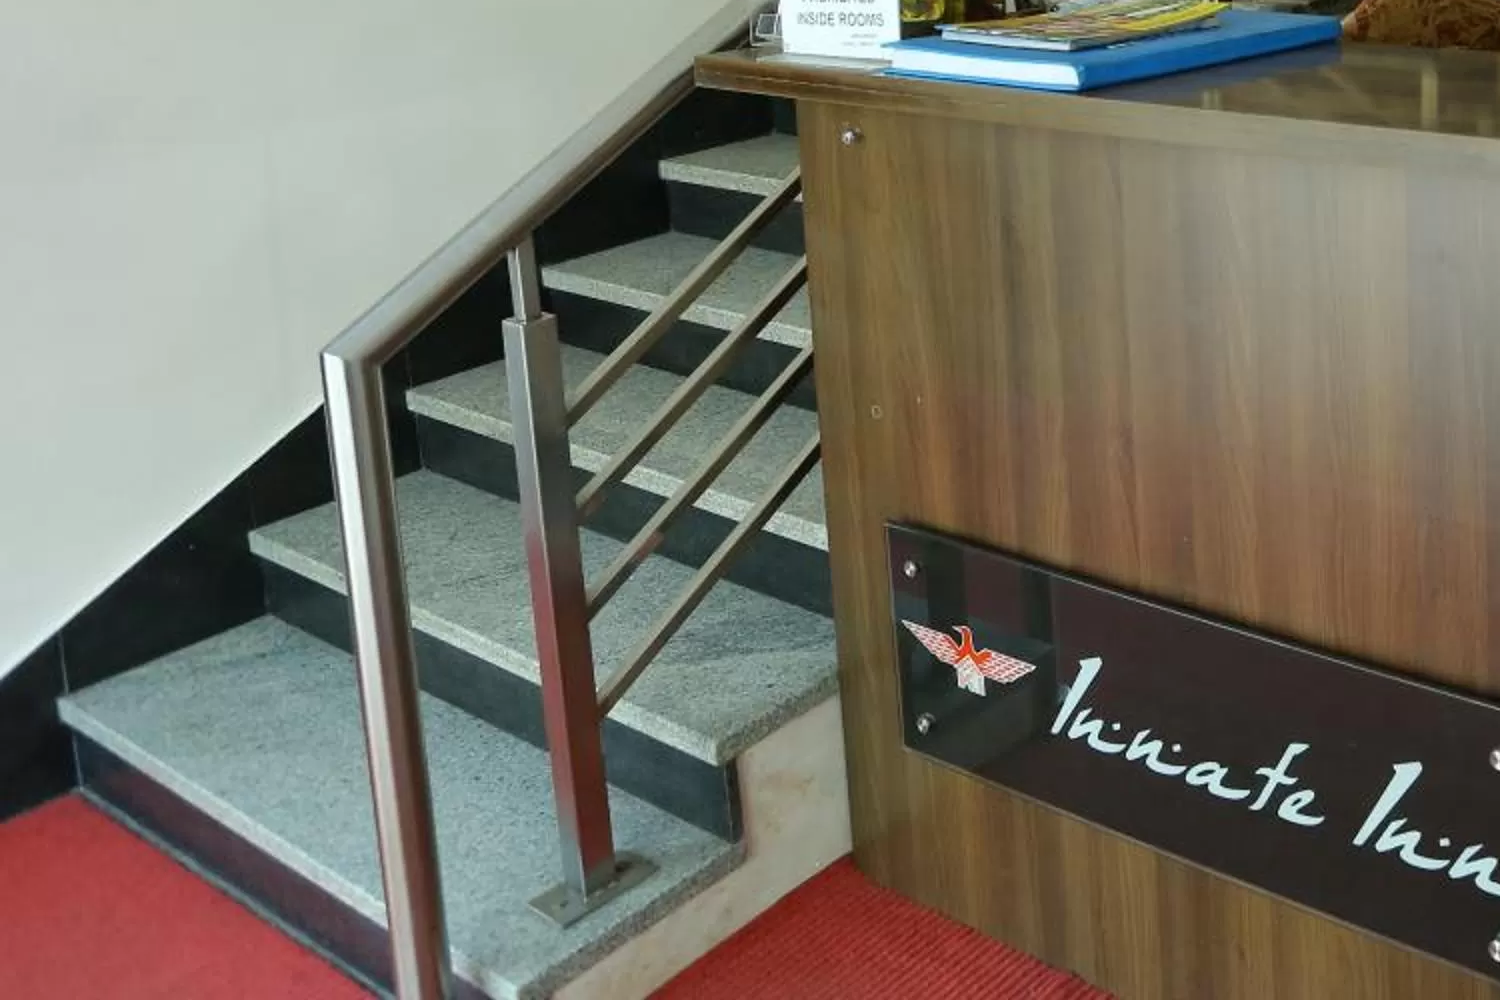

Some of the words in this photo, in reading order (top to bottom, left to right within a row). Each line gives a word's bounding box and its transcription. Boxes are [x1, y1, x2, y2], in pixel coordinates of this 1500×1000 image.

[797, 11, 835, 26] INSIDE
[838, 12, 885, 27] ROOMS
[1050, 656, 1325, 826] Innate
